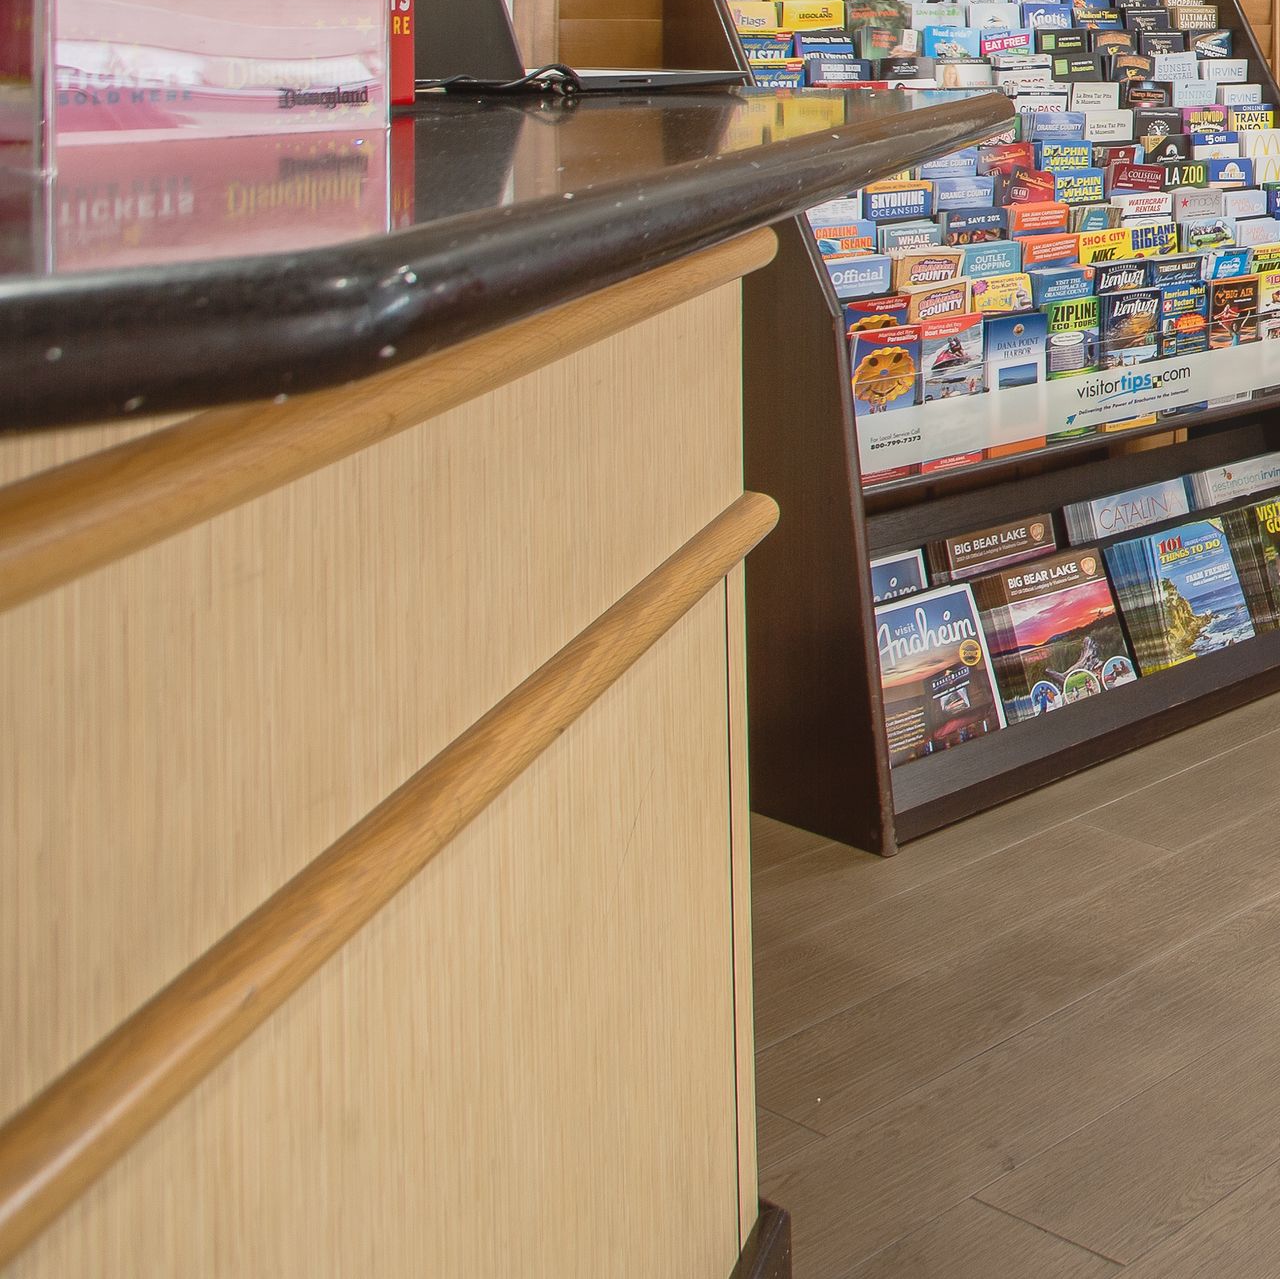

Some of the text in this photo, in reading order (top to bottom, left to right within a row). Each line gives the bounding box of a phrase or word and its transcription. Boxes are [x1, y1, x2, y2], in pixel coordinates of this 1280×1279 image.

[798, 11, 833, 19] LEGOLAND
[1028, 10, 1068, 28] Knott's
[1075, 7, 1102, 20] Medieval
[1179, 13, 1217, 22] ULTIMATE
[741, 15, 766, 28] Flags
[1179, 21, 1217, 29] SHOPPING
[985, 35, 1028, 51] EAT FREE
[1157, 63, 1193, 73] SUNSET
[1212, 67, 1243, 77] IRVINE
[1157, 72, 1194, 81] COCKTAIL
[1178, 90, 1213, 100] DINING
[1227, 93, 1258, 103] IRVINE
[1235, 113, 1270, 123] TRAVEL
[1059, 124, 1082, 132] COUNTY
[1043, 145, 1089, 158] DOLPHIN
[950, 158, 975, 167] COUNTY
[1050, 157, 1089, 166] WHALE
[1128, 170, 1162, 181] COLISEUM
[1165, 165, 1204, 185] LA ZOO
[1057, 176, 1102, 188] DOLPHIN
[940, 188, 991, 200] ORANGE COUNTY
[1063, 187, 1102, 197] WHALE
[871, 190, 925, 209] SKYDIVING
[1128, 197, 1168, 207] WATERCRAFT
[871, 206, 924, 218] OCEANSIDE
[1135, 204, 1161, 213] RENTALS
[968, 214, 1001, 225] SAVE 20%
[815, 226, 858, 239] CATALINA
[1131, 223, 1176, 240] BIPLANE
[840, 236, 872, 250] ISLAND
[898, 234, 930, 245] WHALE
[1082, 232, 1126, 246] SHOE CITY
[975, 253, 1006, 264] OUTLET
[1090, 247, 1117, 262] NIKE
[969, 261, 1011, 272] SHOPPING
[831, 266, 884, 285] Official
[910, 270, 954, 283] COUNTY
[1100, 270, 1145, 290] Ventura
[1163, 289, 1189, 300] American
[1225, 287, 1254, 300] BIG AIR
[918, 299, 963, 318] COUNTY
[1053, 302, 1098, 322] ZIPLINE
[1113, 298, 1159, 317] Ventura
[1052, 319, 1098, 331] ECO-TOURS
[996, 336, 1040, 352] DANA POINT
[1003, 347, 1032, 359] HARBOR
[1078, 406, 1103, 416] Delivering
[1103, 402, 1111, 411] the
[1112, 400, 1127, 411] Power
[1134, 395, 1156, 406] Brochures
[869, 436, 878, 444] For
[879, 433, 892, 442] Local
[893, 430, 910, 439] Service
[1099, 491, 1185, 530] CATALINA
[954, 527, 1028, 556] BIG BEAR LAKE
[1157, 535, 1183, 555] 101
[1160, 538, 1221, 565] THINGS TO DO
[1007, 561, 1078, 589] BIG BEAR LAKE
[1185, 569, 1205, 585] FARM
[895, 622, 916, 636] visit
[877, 608, 976, 666] Anaheim
